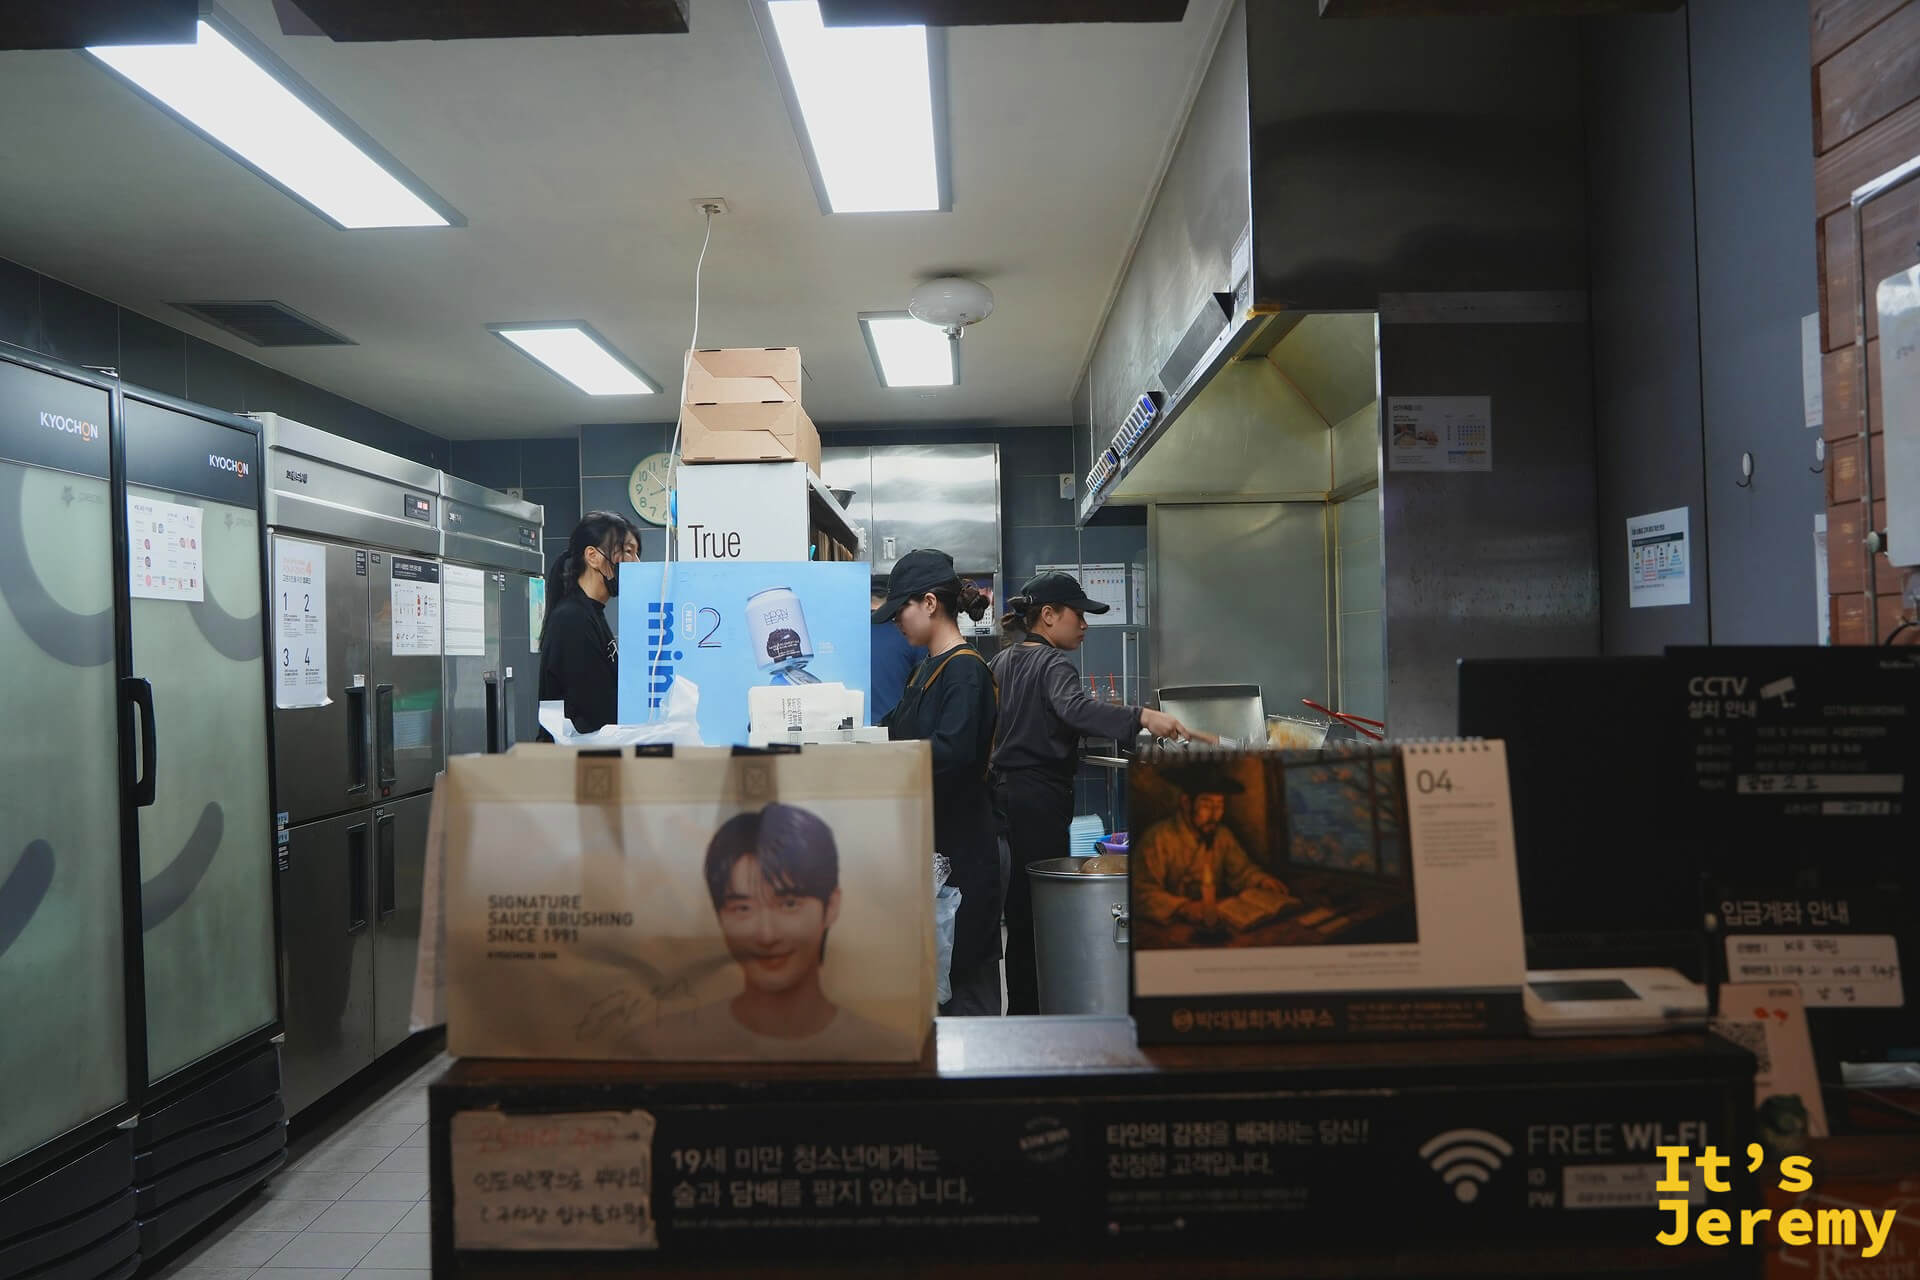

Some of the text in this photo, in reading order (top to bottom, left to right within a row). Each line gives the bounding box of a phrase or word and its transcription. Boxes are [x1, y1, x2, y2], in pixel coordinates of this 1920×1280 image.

[40, 411, 98, 440] KYOCHON
[209, 454, 249, 477] KYOCHON
[649, 461, 656, 472] 11
[639, 470, 648, 482] 10
[635, 483, 643, 494] 9
[639, 497, 647, 508] 8
[649, 506, 656, 517] 7
[687, 525, 741, 559] True
[283, 592, 288, 610] 1
[304, 594, 310, 612] 2
[697, 607, 722, 648] 2
[283, 648, 289, 667] 3
[304, 648, 310, 666] 4
[1688, 675, 1748, 697] CCTV
[1688, 700, 1757, 719] 설치 안내
[1416, 769, 1453, 794] 04
[487, 895, 581, 910] SIGNATURE
[487, 911, 634, 927] SAUCE BRUSHING
[1721, 899, 1849, 927] 입금계좌 안내
[487, 928, 579, 943] SINCE 1991
[1105, 1121, 1167, 1149] 타인의
[1528, 1120, 1708, 1155] FREE WI-FI
[672, 1143, 940, 1174] 19세 미만 청소년에게는
[672, 1175, 975, 1208] 술과 담배를 팔지 않습니다.
